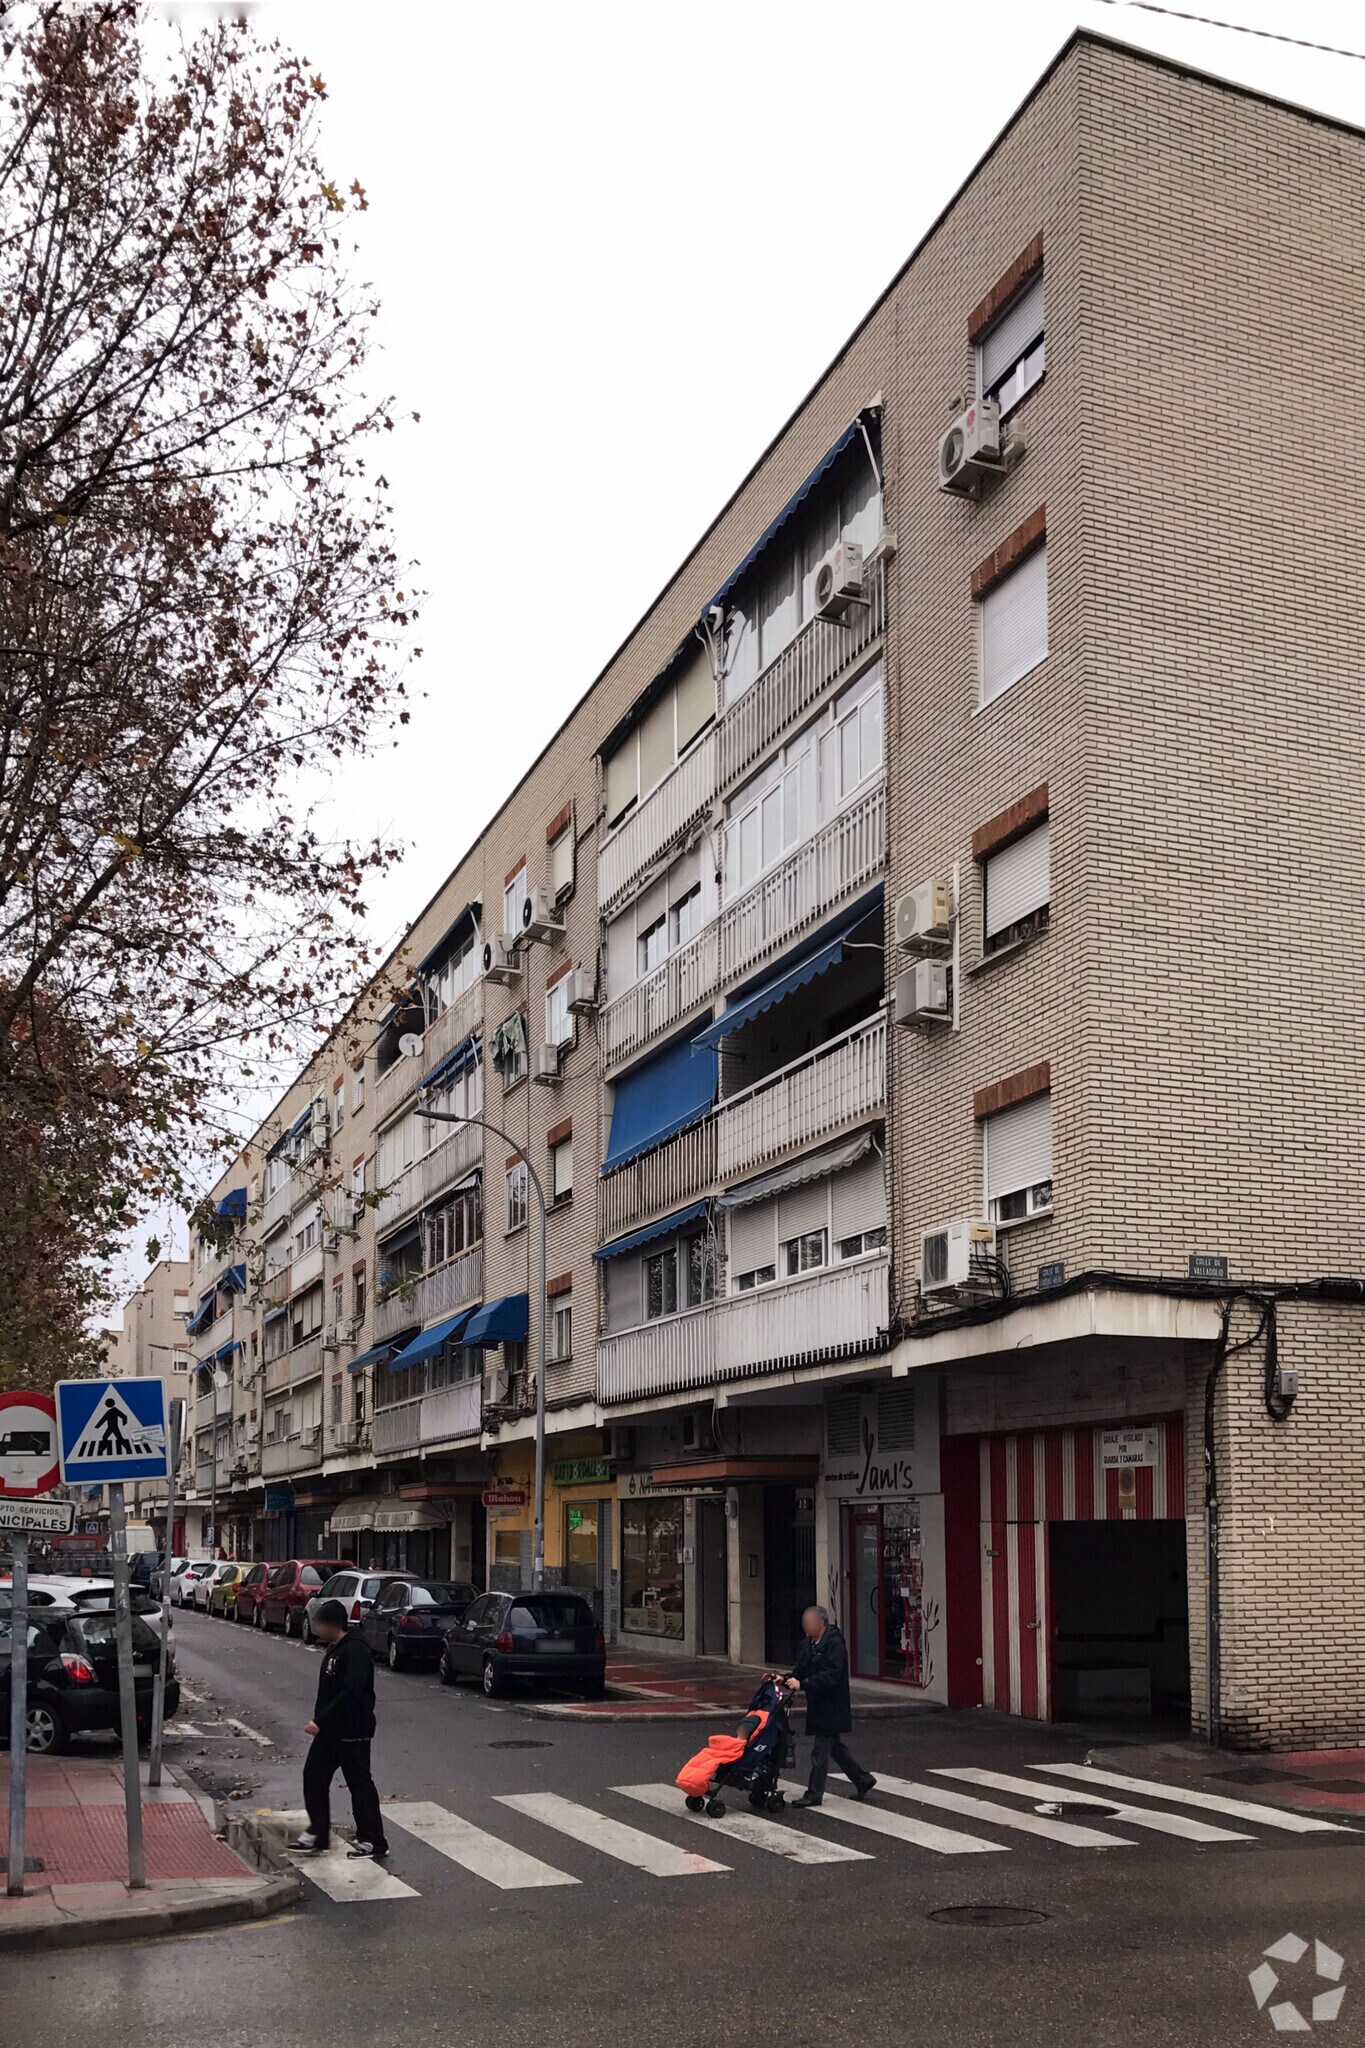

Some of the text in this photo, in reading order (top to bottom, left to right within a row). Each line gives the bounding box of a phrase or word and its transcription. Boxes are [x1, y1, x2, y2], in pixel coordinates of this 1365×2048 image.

[1195, 1258, 1211, 1266] CALLE
[1104, 1433, 1143, 1444] GARAJE VIGILADO
[1119, 1445, 1127, 1453] POR
[1104, 1455, 1118, 1464] GUARDA
[1123, 1454, 1143, 1463] CAMARAS
[487, 1493, 522, 1503] Mahou
[19, 1506, 60, 1516] SERVICIOS
